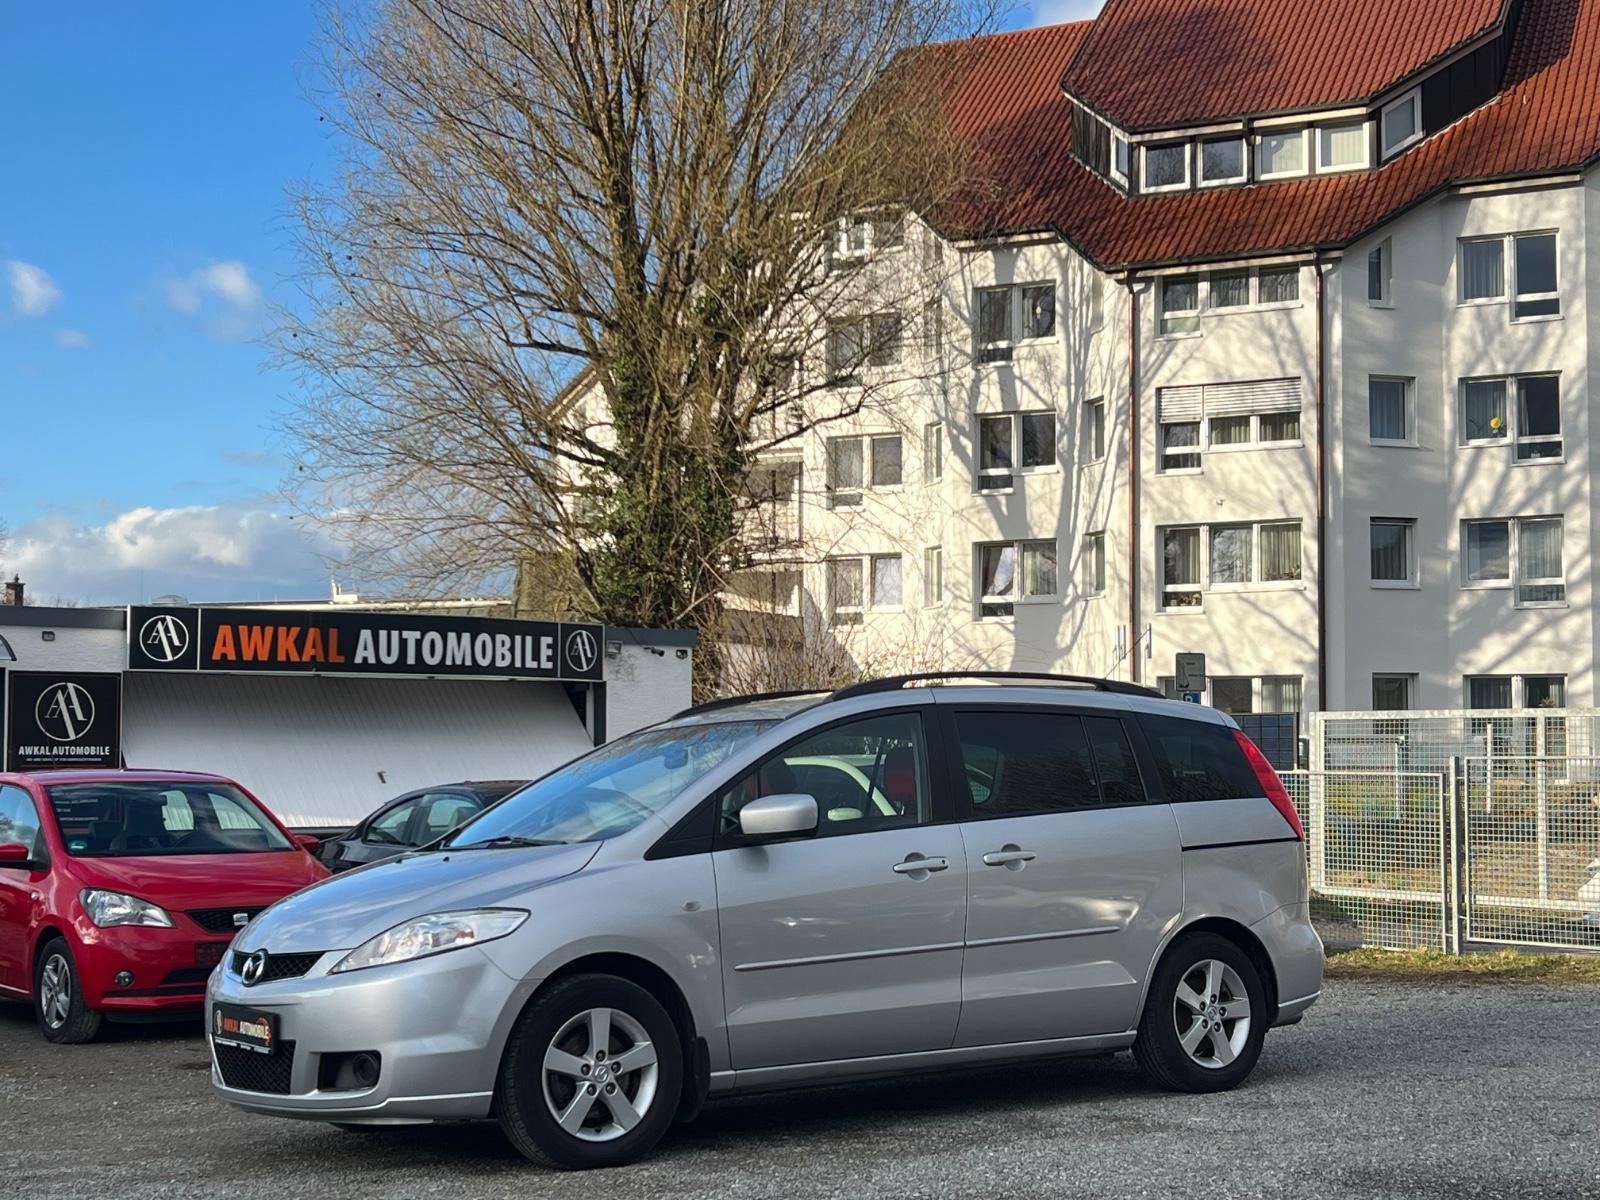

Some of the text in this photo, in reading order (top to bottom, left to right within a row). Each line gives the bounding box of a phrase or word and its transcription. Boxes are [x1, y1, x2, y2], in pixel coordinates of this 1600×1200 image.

[211, 624, 553, 669] AWKAL AUTOMOBILE
[18, 745, 110, 756] AWKAL AUTOMOBILE
